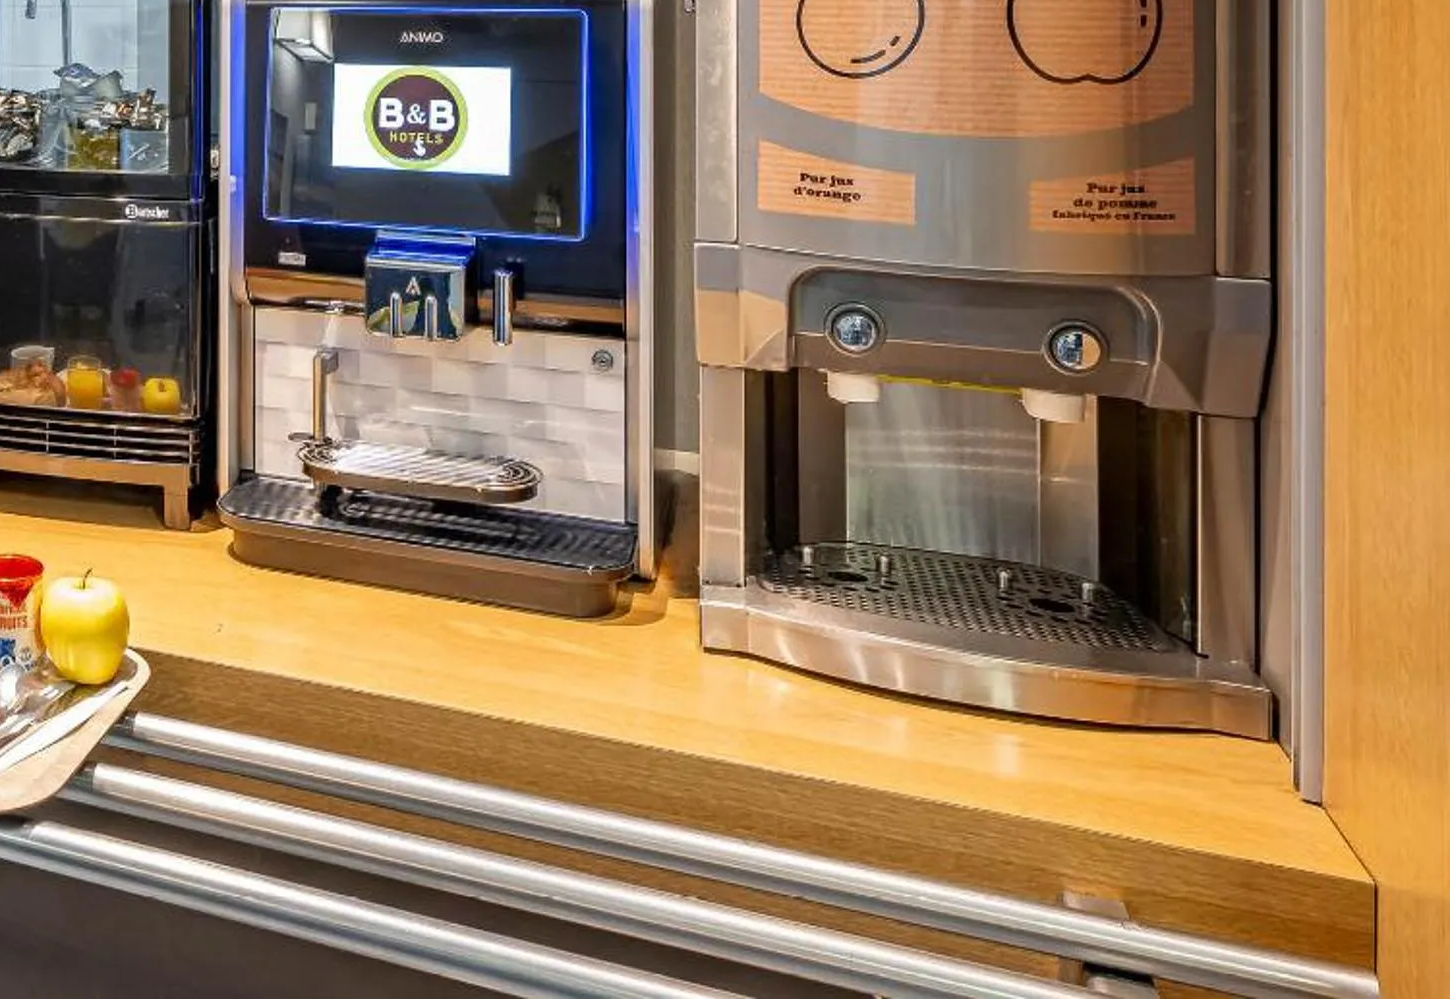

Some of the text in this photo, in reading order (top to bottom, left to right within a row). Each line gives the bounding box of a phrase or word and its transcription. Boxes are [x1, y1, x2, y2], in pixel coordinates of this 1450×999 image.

[378, 97, 455, 132] B&B
[389, 131, 445, 144] HOTELS
[799, 172, 854, 188] Pur jus
[793, 186, 862, 203] d'orange
[1086, 182, 1146, 196] Pur jus
